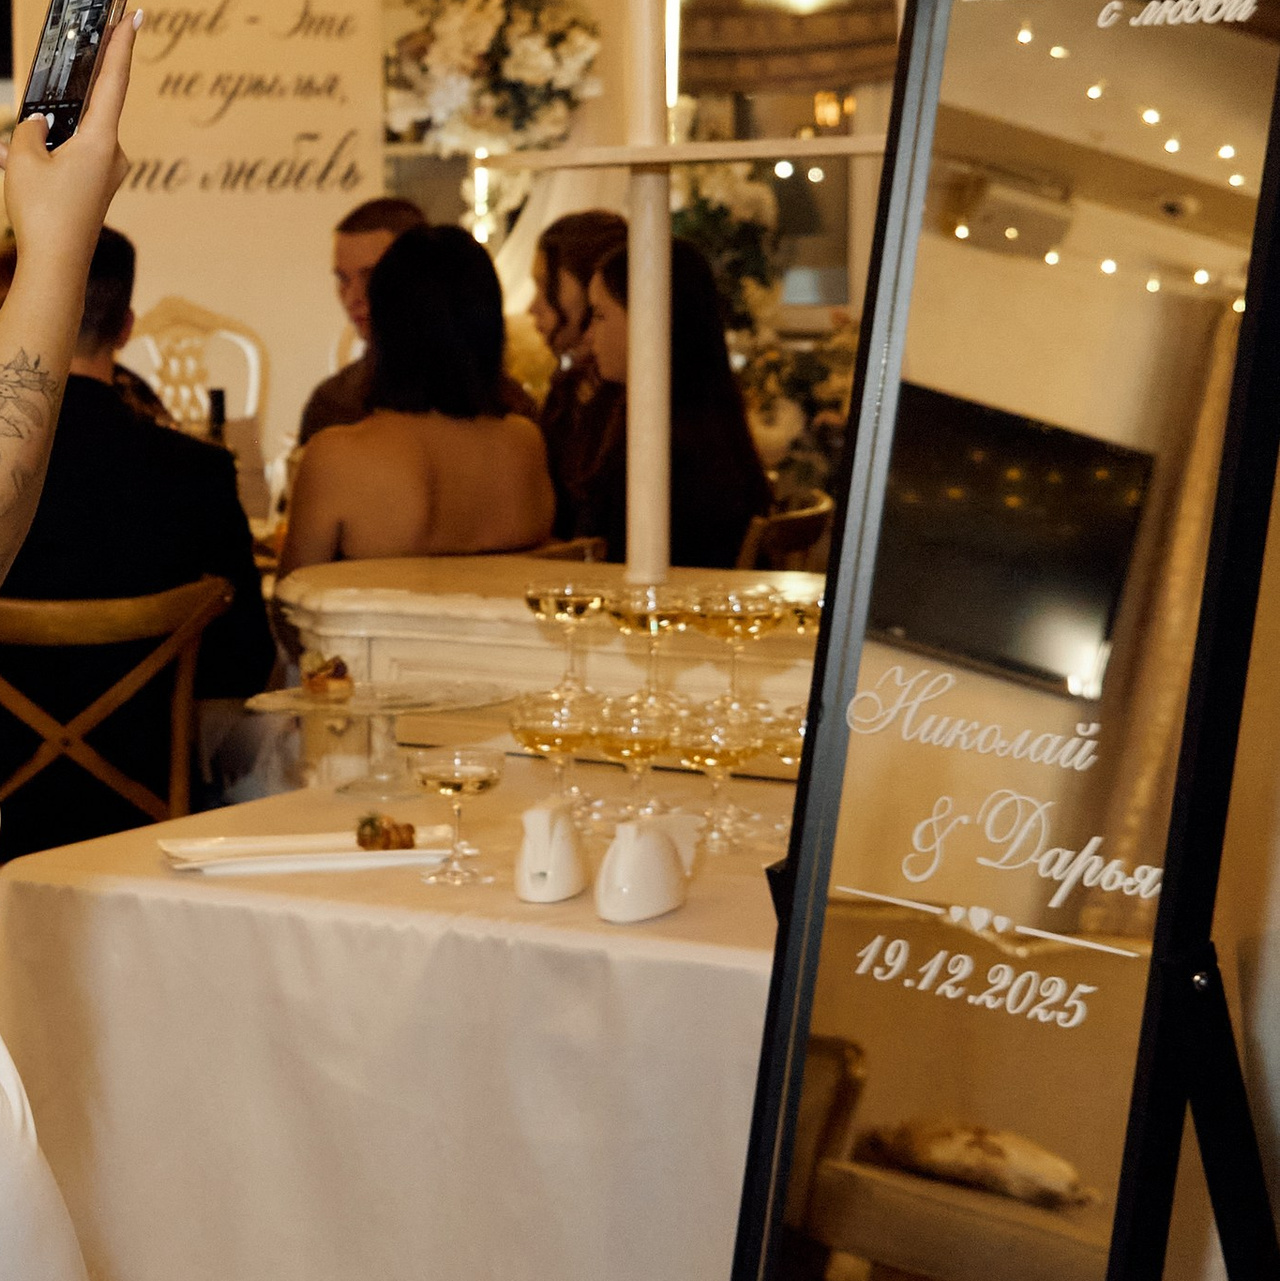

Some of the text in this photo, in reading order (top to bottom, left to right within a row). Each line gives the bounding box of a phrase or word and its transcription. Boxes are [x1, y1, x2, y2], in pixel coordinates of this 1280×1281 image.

[1097, 0, 1124, 29] с
[198, 128, 363, 192] любовь
[845, 665, 1102, 771] Николай
[901, 788, 1163, 908] & Дарья
[855, 933, 1099, 1028] 19.12.2025
